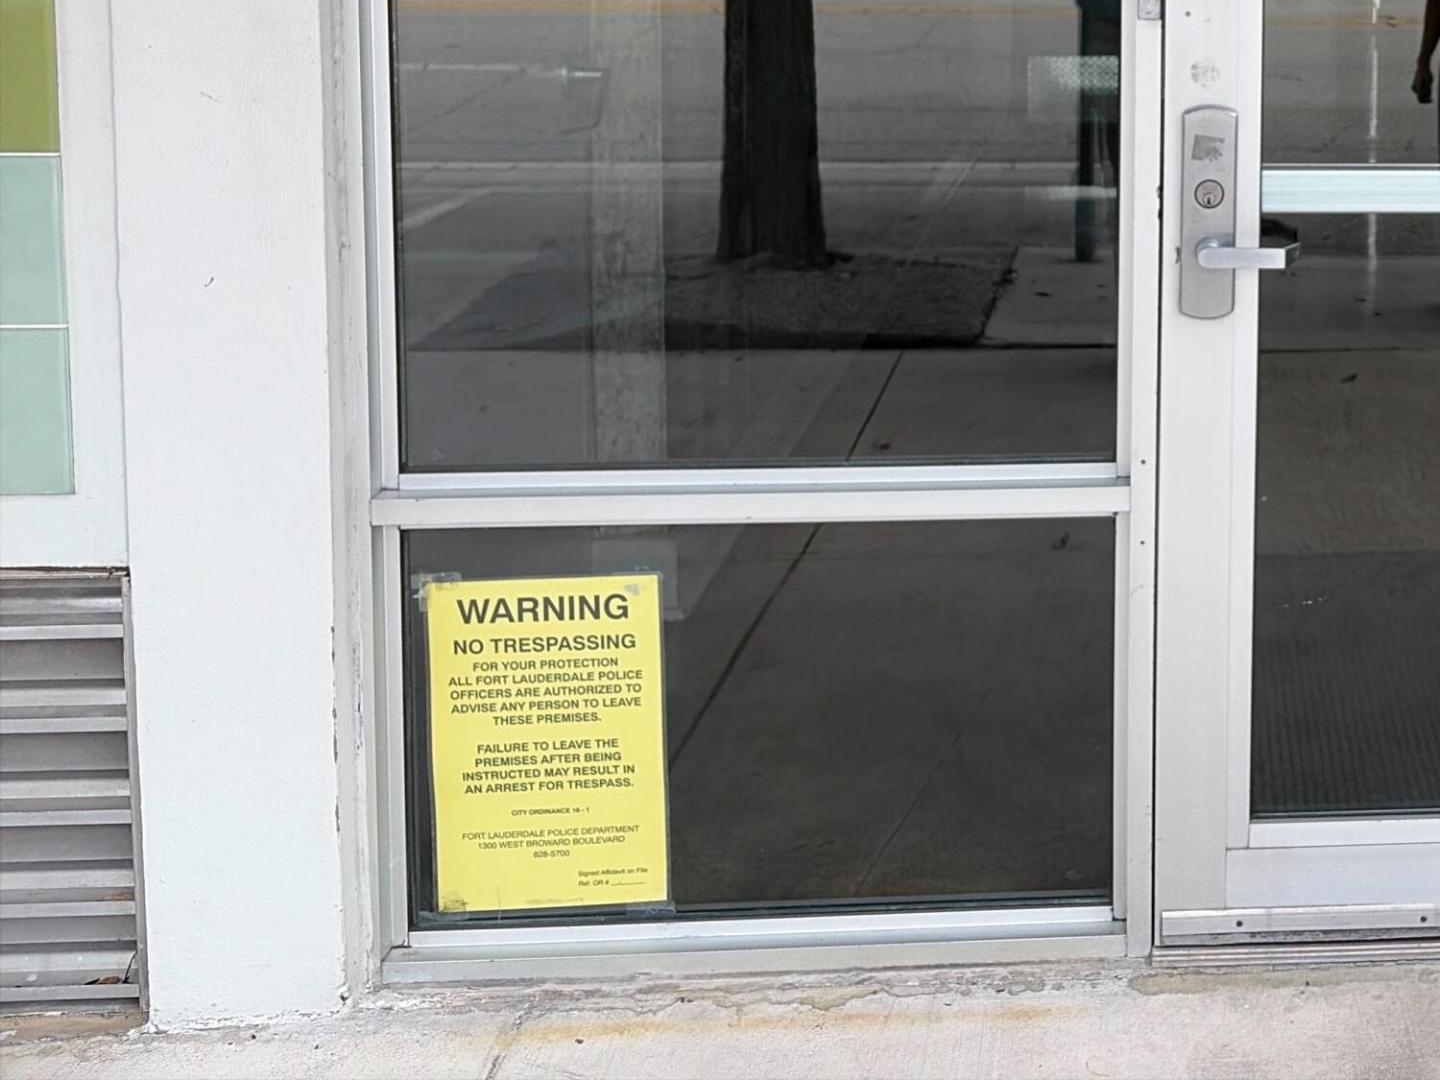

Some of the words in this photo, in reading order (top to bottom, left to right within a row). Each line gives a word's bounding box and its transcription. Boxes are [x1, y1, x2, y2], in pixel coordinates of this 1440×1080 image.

[457, 593, 629, 624] WARNING
[453, 639, 484, 655] NO
[490, 633, 636, 653] TRESPASSING
[473, 661, 498, 672] FOR
[501, 660, 536, 671] YOUR
[540, 657, 619, 669] PROTECTION
[448, 676, 472, 687] ALL
[476, 675, 509, 686] FORT
[513, 672, 595, 684] LAUDERDALE
[598, 670, 643, 681] POLICE
[450, 689, 512, 701] OFFICERS
[515, 687, 540, 698] ARE
[543, 685, 622, 697] AUTHORIZED
[625, 683, 642, 694] TO
[451, 703, 496, 715] ADVISE
[500, 701, 526, 712] ANY
[529, 700, 580, 711] PERSON
[583, 698, 599, 709] TO
[602, 696, 642, 708] LEAVE
[493, 715, 533, 726] THESE
[537, 712, 602, 724] PREMISES.
[477, 742, 529, 754] FAILURE
[533, 741, 549, 752] TO
[552, 739, 592, 750] LEAVE
[595, 738, 619, 749] THE
[475, 755, 538, 768] PREMISES
[540, 753, 580, 764] AFTER
[584, 751, 622, 762] BEING
[462, 769, 541, 782] INSTRUCTED
[544, 767, 569, 777] MAY
[573, 765, 620, 777] RESULT
[623, 764, 635, 774] IN
[465, 783, 483, 794] AN
[486, 781, 535, 793] ARREST
[538, 780, 564, 791] FOR
[567, 777, 634, 789] TRESPASS.
[528, 807, 570, 816] ORDINANCE
[462, 831, 485, 841] FORT
[488, 828, 546, 840] LAUDERDALE
[547, 827, 579, 837] POLICE
[581, 824, 640, 835] DEPARTMENT
[478, 841, 497, 850] 1300
[499, 839, 524, 849] WEST
[526, 837, 571, 848] BROWARD
[573, 834, 626, 846] BOULEVARD
